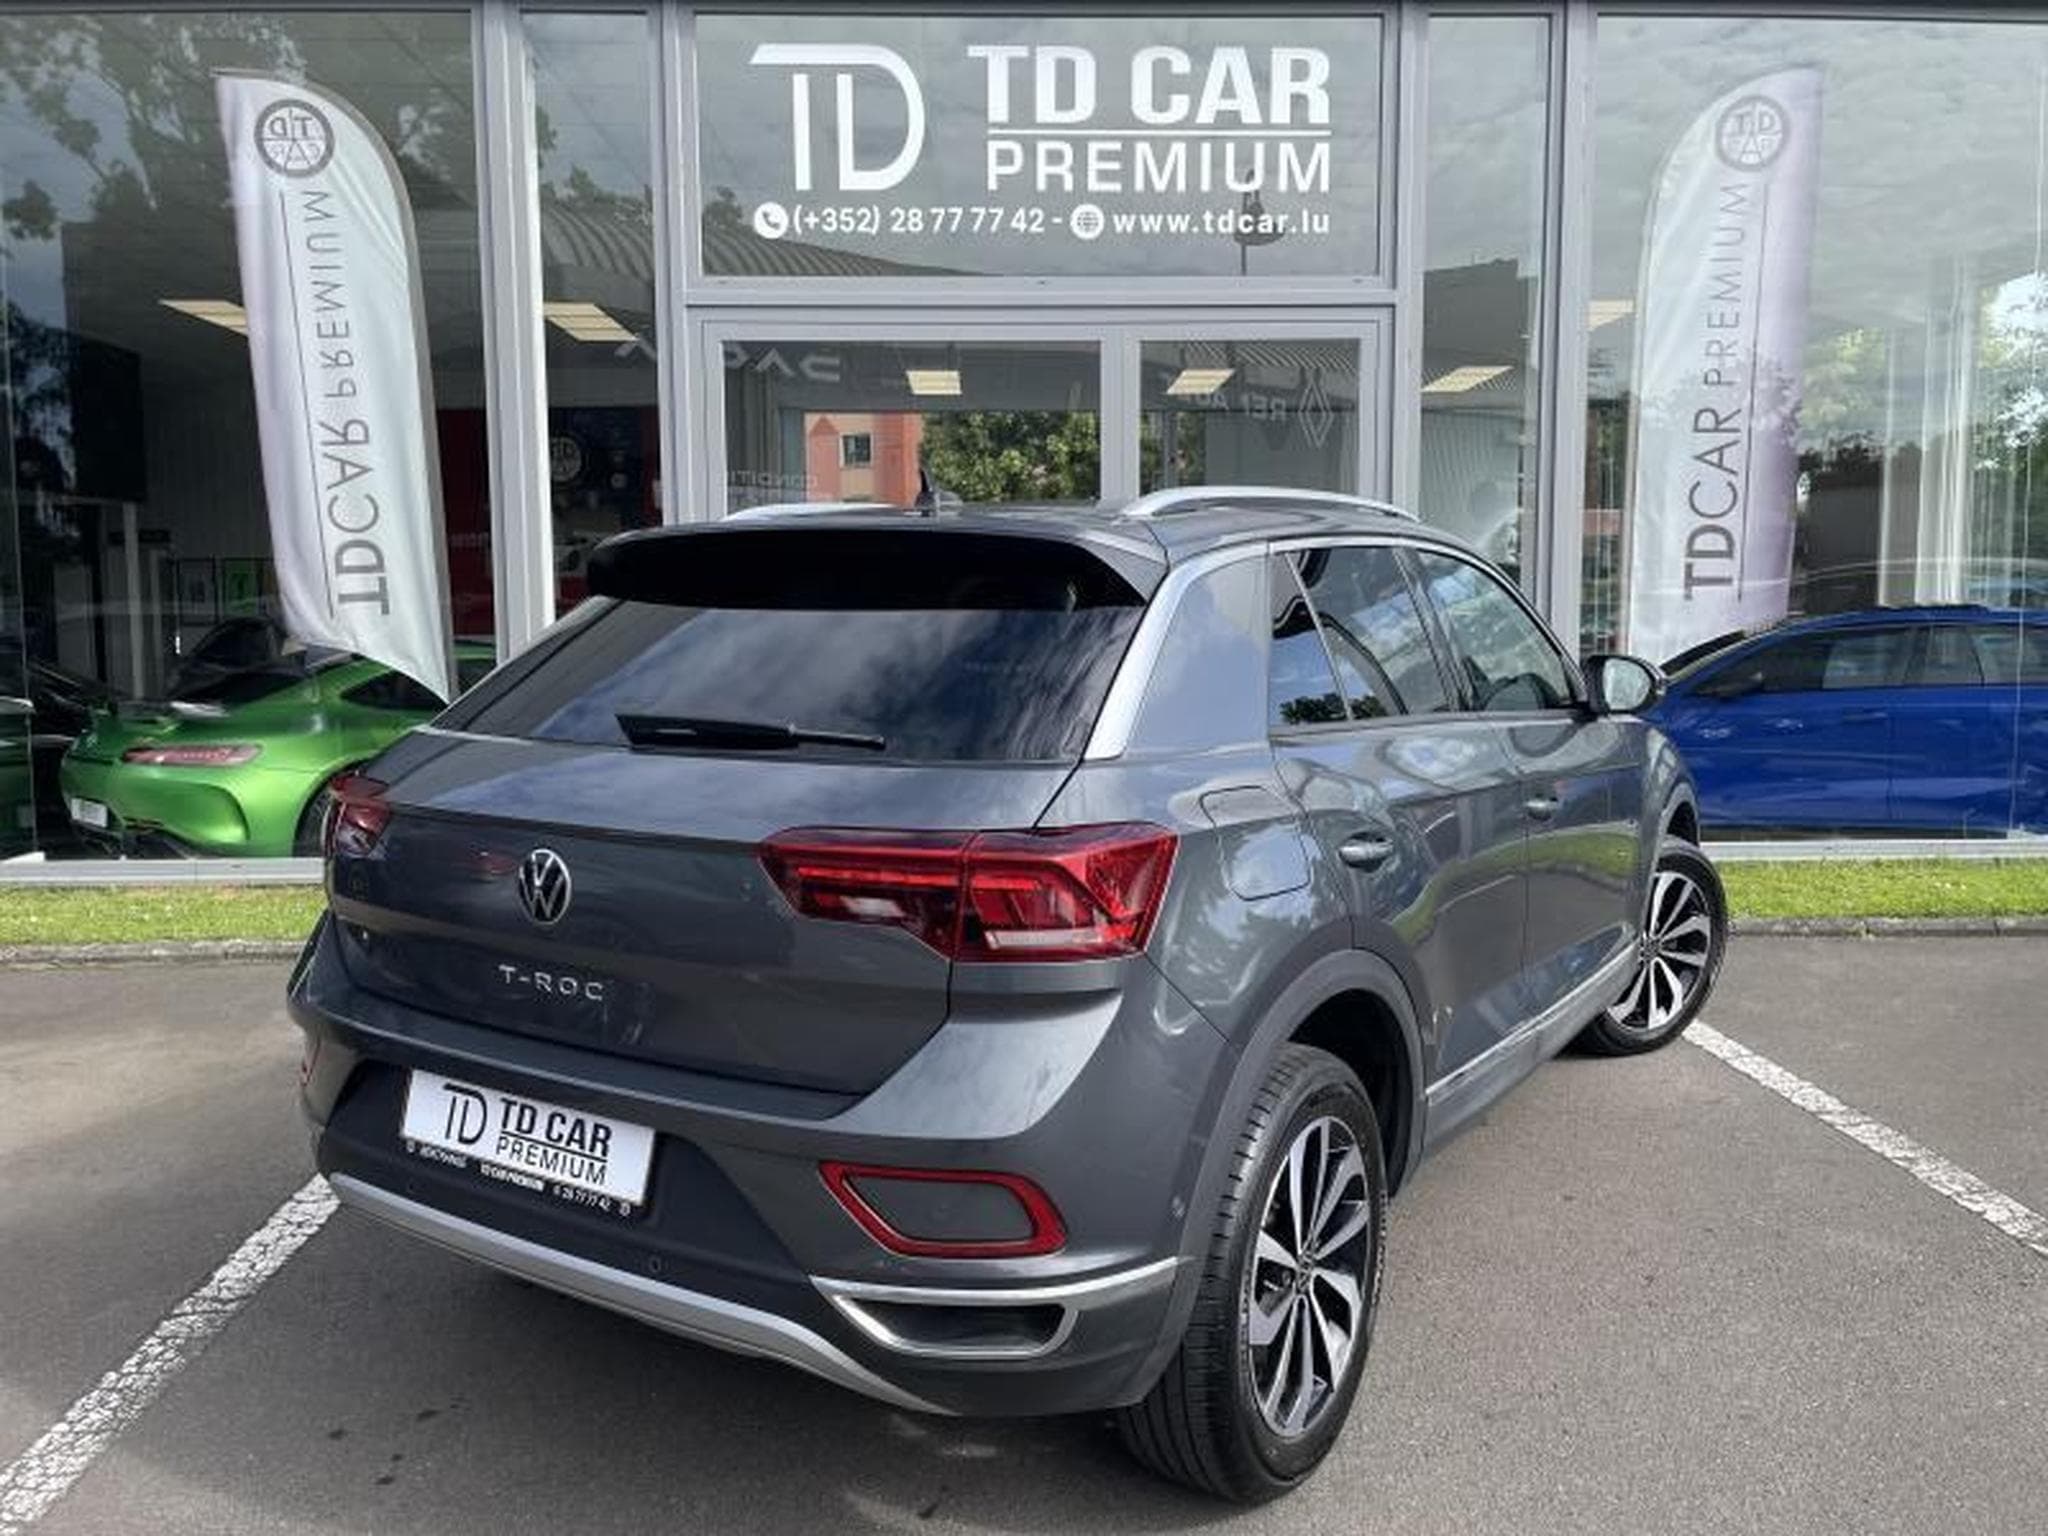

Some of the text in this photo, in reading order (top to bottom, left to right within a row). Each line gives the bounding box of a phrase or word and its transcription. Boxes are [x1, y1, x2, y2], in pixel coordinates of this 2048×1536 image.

[967, 45, 1331, 124] TD CAR
[986, 141, 1332, 192] PREMIUM
[793, 205, 880, 235] (+352)
[890, 207, 924, 233] 28
[930, 207, 964, 233] 77
[971, 207, 1004, 233] 77
[1010, 207, 1045, 233] 42
[1112, 208, 1331, 234] www.tdcar.lu
[1684, 183, 1749, 600] TDCAR PREMIUM
[498, 964, 603, 1001] T-ROC
[499, 1097, 612, 1157] TD CAR
[495, 1135, 608, 1185] PREMIUM
